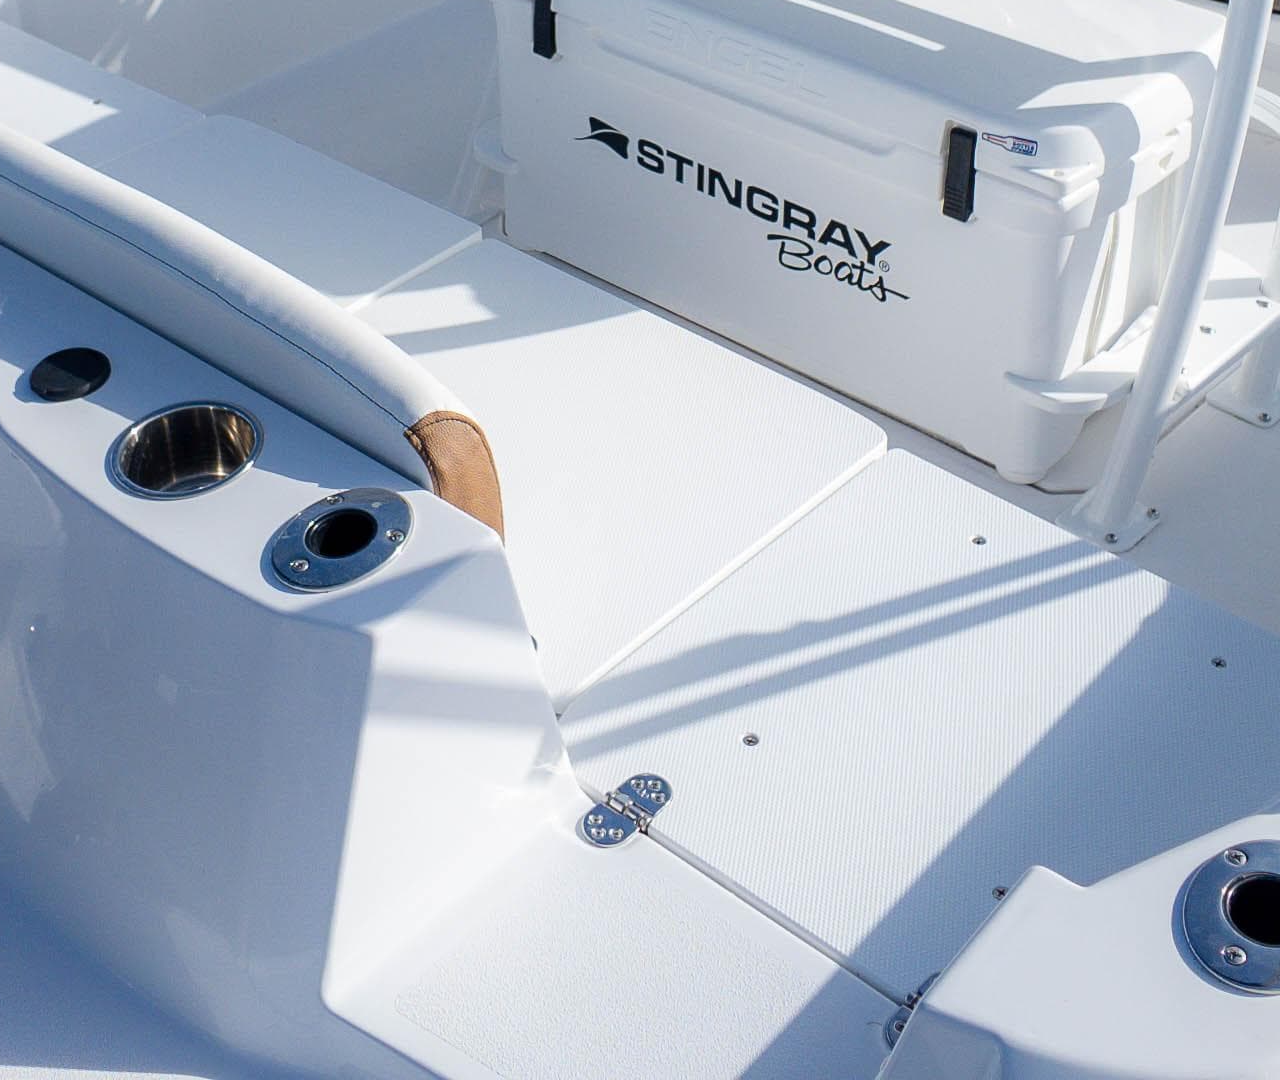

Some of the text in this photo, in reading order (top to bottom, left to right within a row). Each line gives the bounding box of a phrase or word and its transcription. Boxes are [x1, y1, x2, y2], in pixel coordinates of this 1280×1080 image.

[645, 7, 828, 100] ENGEL
[637, 139, 891, 266] STINGRAY
[767, 233, 910, 302] Boats
